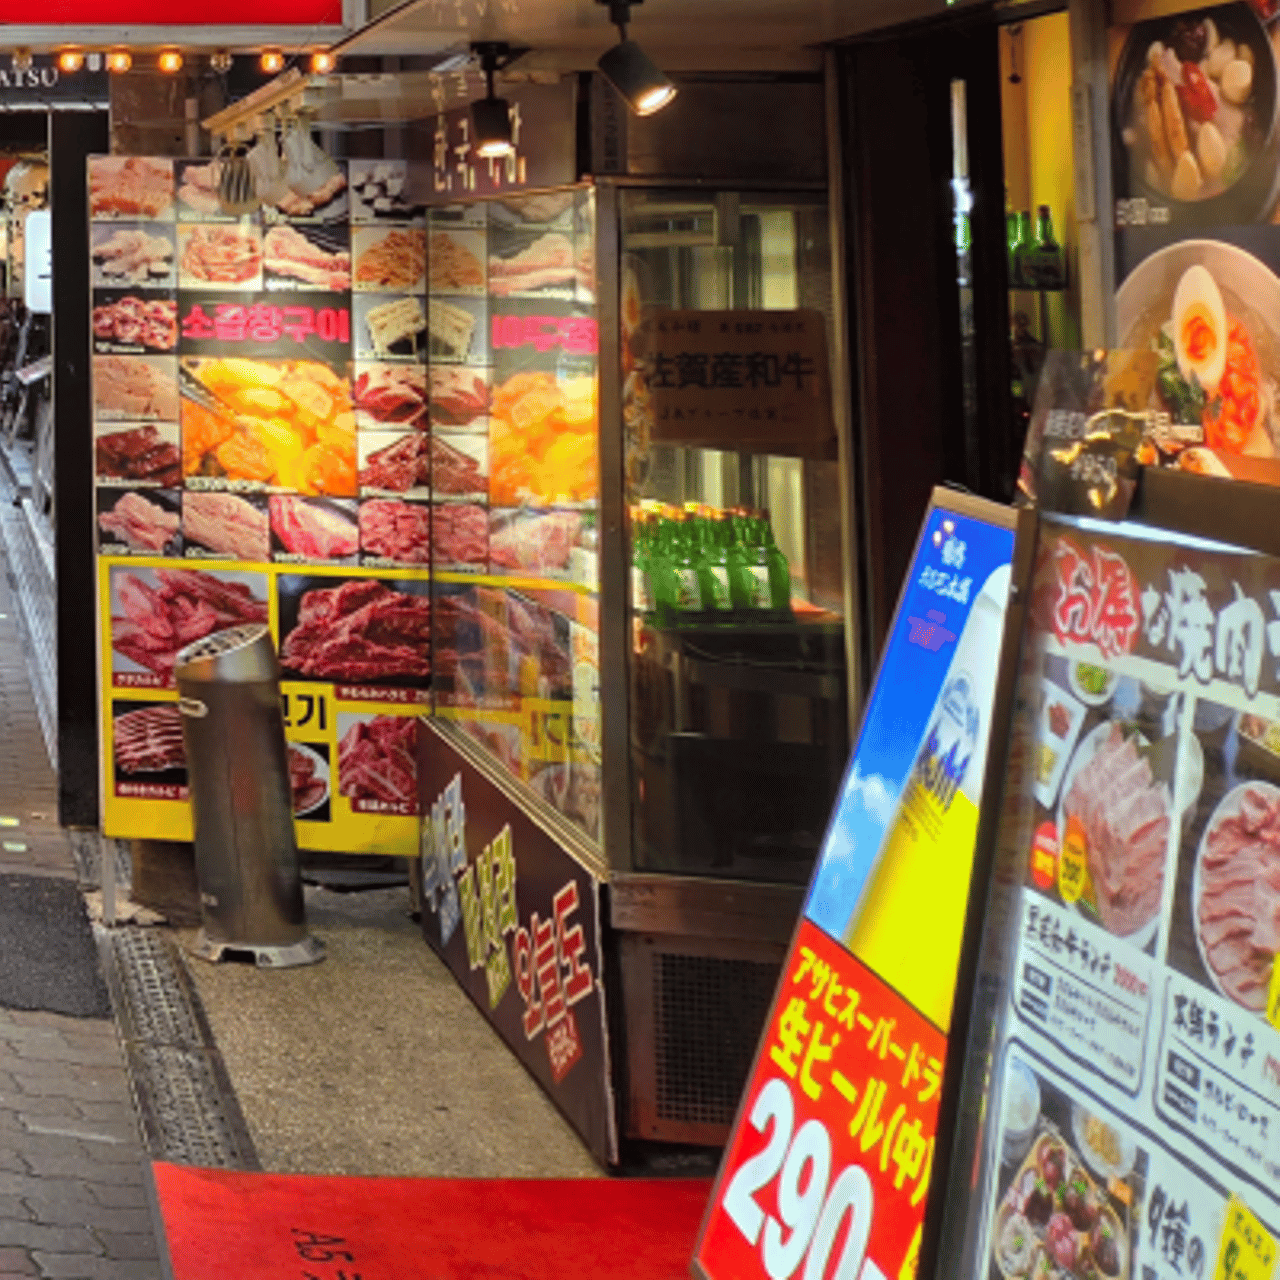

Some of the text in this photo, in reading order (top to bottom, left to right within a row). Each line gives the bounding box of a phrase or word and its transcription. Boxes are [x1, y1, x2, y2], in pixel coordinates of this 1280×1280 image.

[1054, 537, 1280, 700] お得な焼肉
